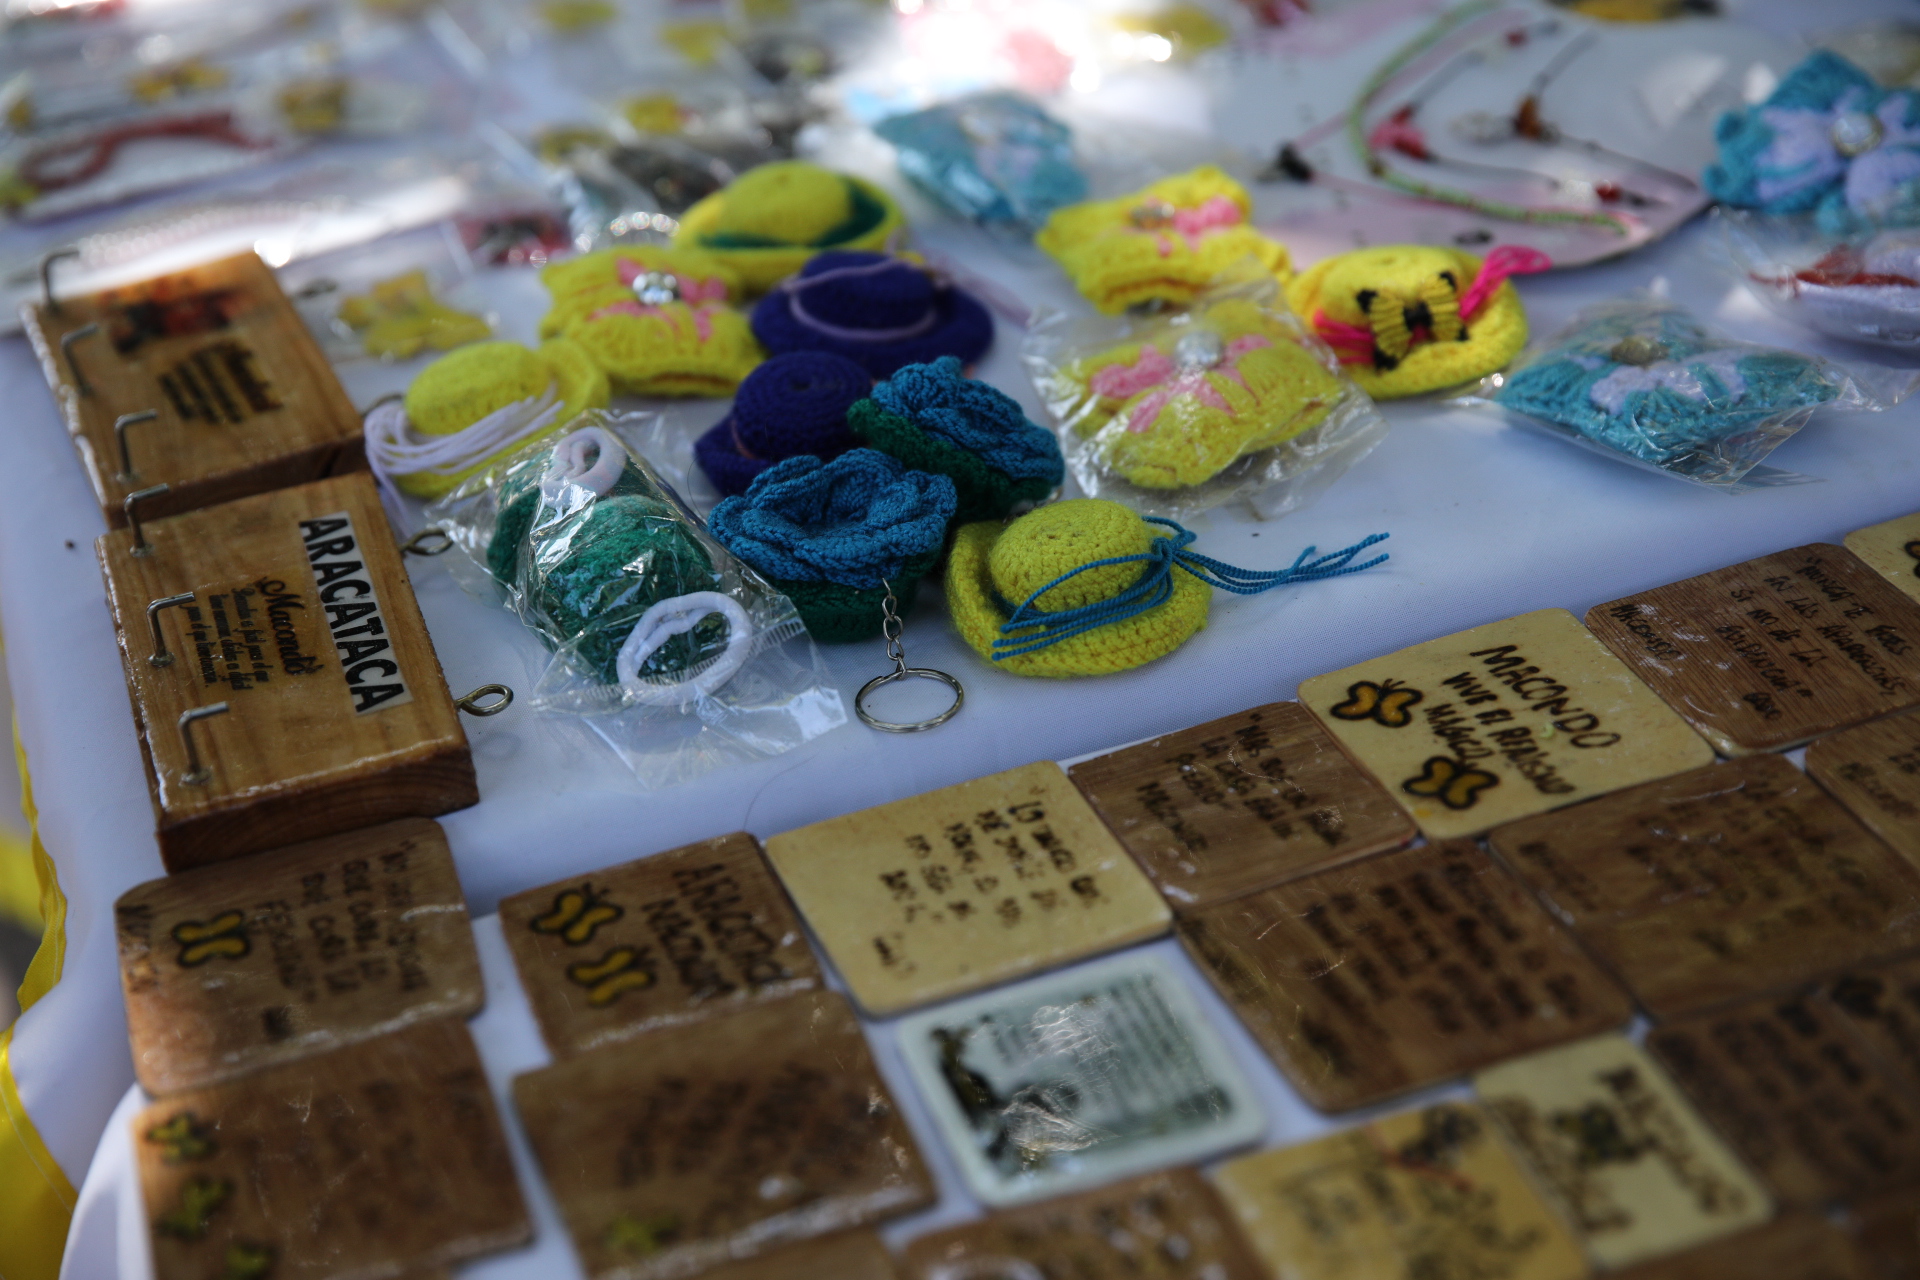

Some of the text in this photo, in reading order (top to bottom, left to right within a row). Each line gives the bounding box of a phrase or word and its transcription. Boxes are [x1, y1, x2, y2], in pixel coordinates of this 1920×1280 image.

[256, 579, 317, 676] Macondo
[298, 519, 404, 713] ARACATACA
[1747, 609, 1779, 629] NO
[1469, 645, 1621, 748] MACONDO
[1475, 709, 1514, 725] EL
